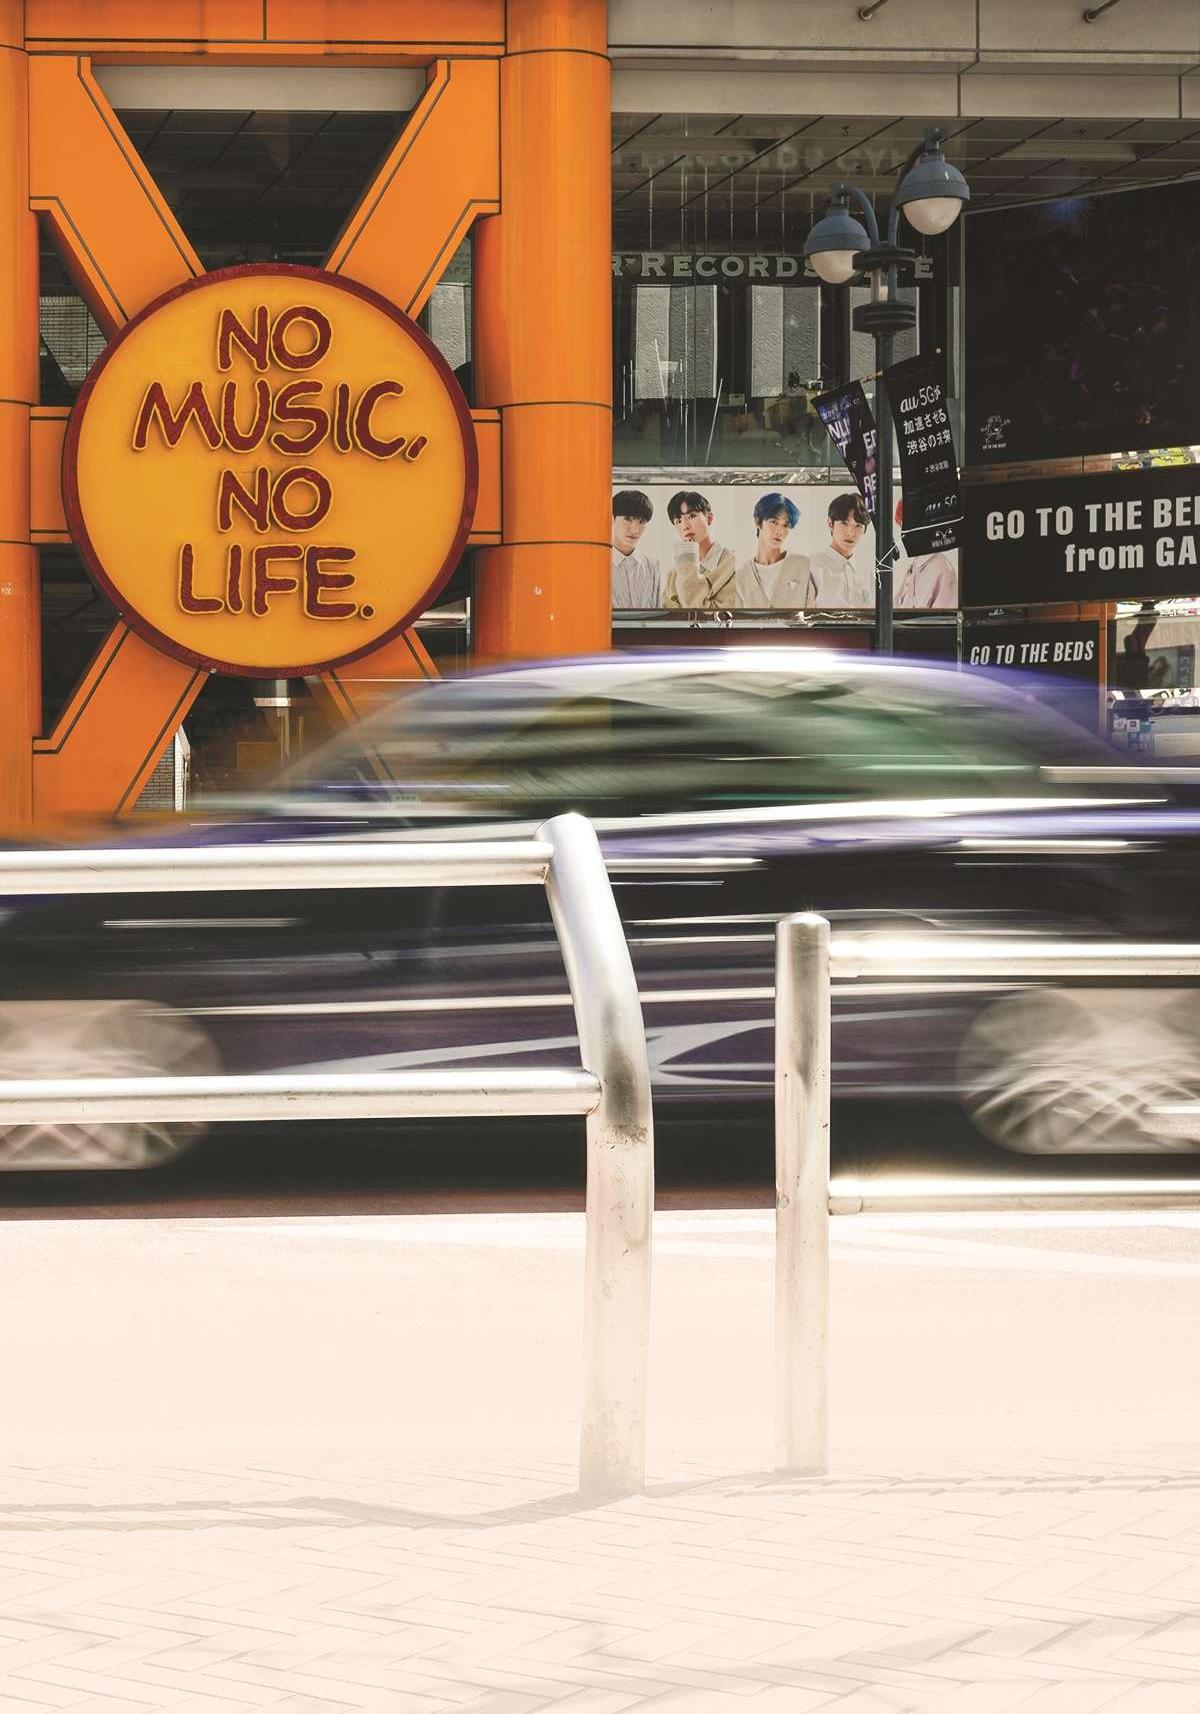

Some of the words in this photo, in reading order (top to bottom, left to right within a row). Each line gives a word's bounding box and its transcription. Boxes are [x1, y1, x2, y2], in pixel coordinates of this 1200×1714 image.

[217, 304, 332, 372] NO
[132, 378, 428, 461] MUSIC,
[900, 396, 919, 413] au
[903, 408, 947, 434] 加速させる
[906, 429, 952, 455] 渋谷の未来
[217, 465, 333, 534] NO
[986, 509, 1025, 541] GO
[1036, 505, 1074, 537] TO
[1085, 500, 1142, 533] THE
[1065, 543, 1144, 573] from
[179, 543, 375, 620] LIFE.
[969, 646, 990, 666] GO
[996, 645, 1015, 665] TO
[1020, 643, 1050, 664] THE
[1053, 640, 1094, 663] BEDS
